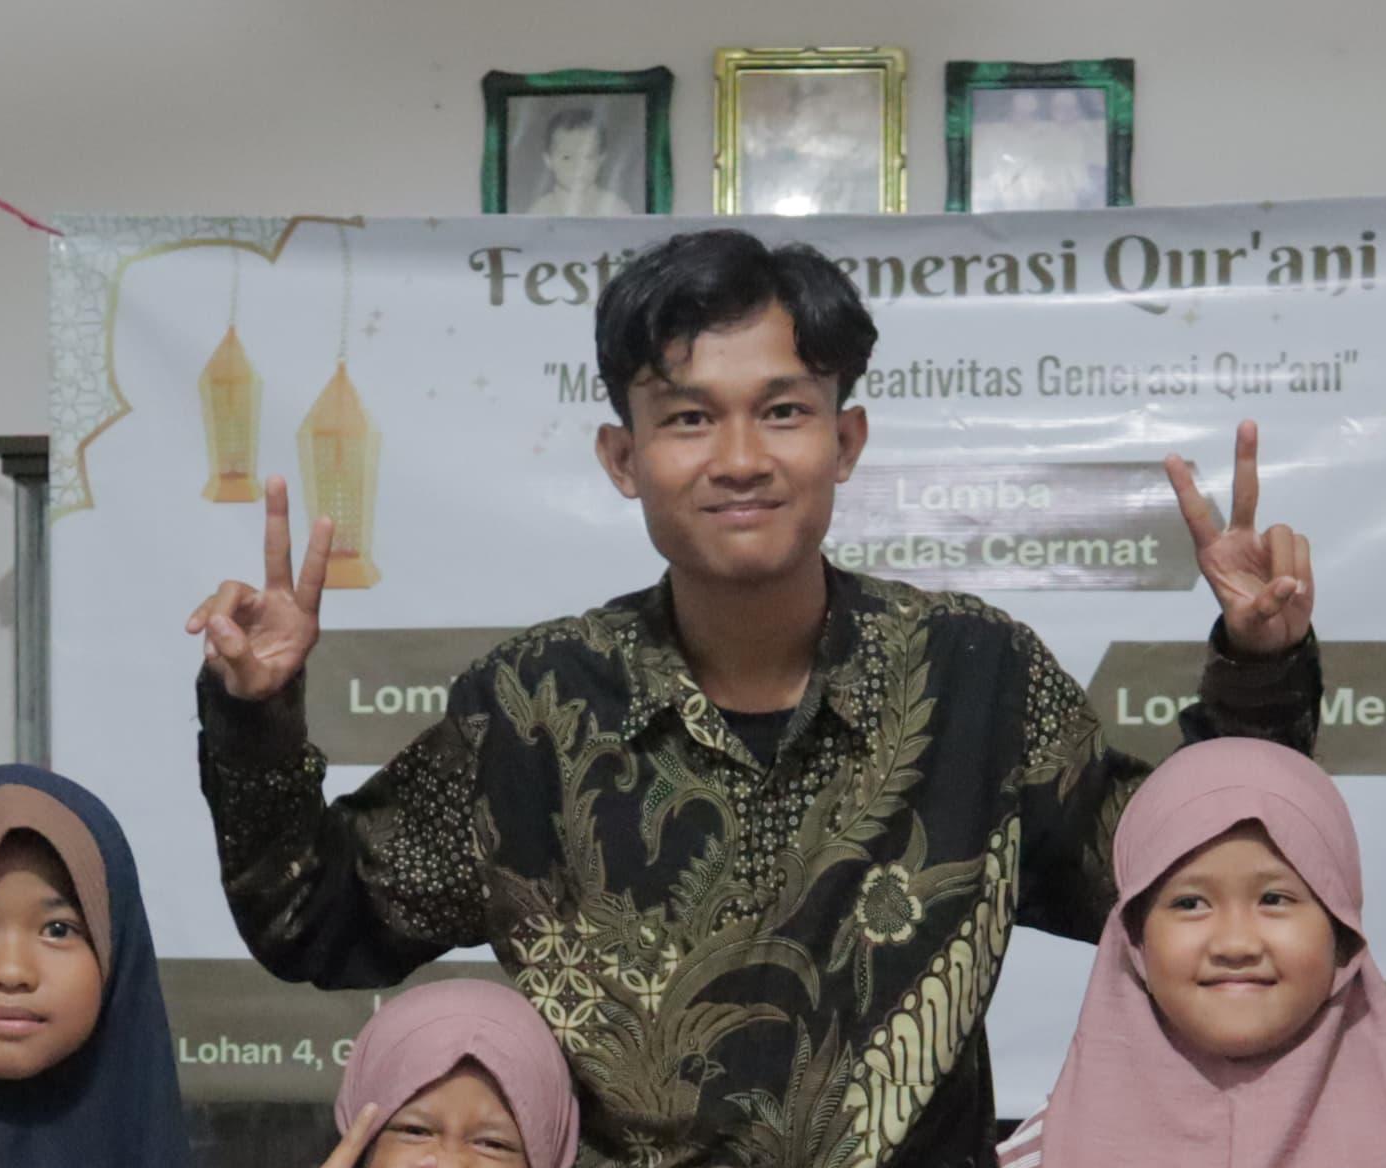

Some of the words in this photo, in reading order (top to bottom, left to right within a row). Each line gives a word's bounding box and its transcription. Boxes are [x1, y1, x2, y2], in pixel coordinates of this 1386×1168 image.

[1103, 230, 1377, 314] Qur'ani
[1037, 354, 1198, 397] Generasi
[1214, 350, 1359, 400] Qur'ani"
[896, 477, 1052, 511] Lomba
[980, 533, 1159, 567] Cermat
[350, 676, 459, 715] Lom
[178, 1035, 283, 1065] Lohan
[291, 1038, 324, 1072] 4,
